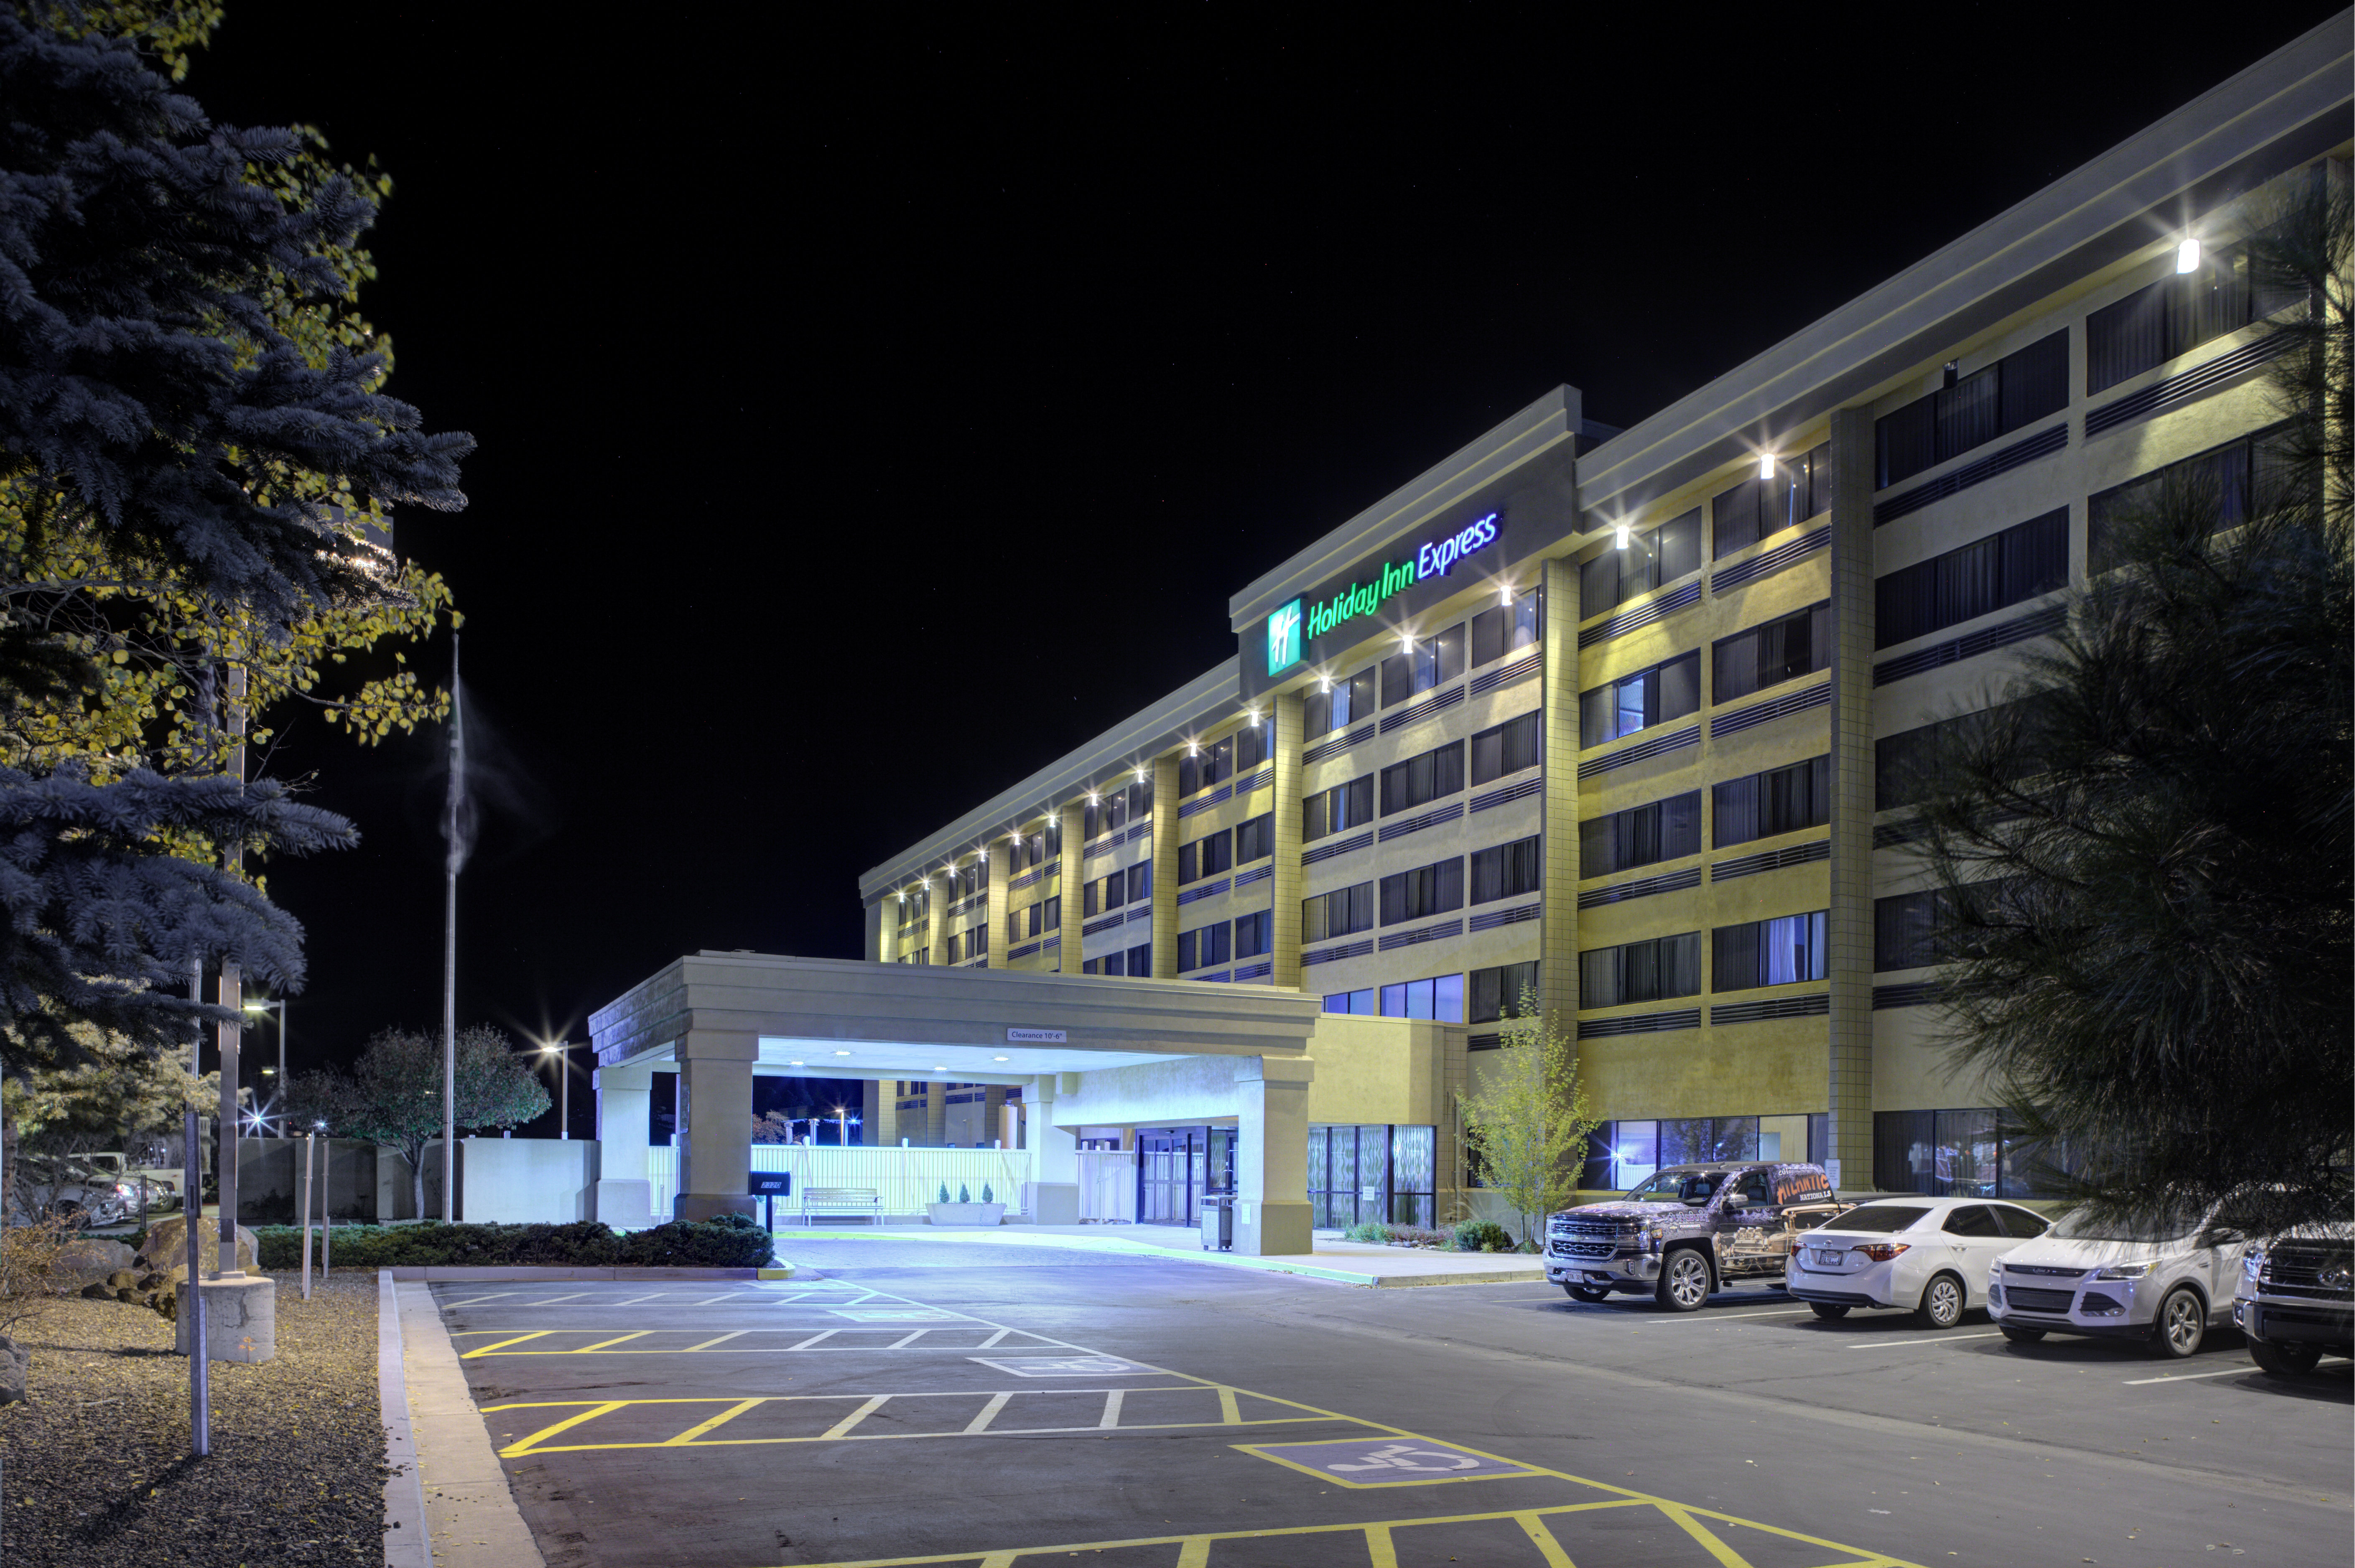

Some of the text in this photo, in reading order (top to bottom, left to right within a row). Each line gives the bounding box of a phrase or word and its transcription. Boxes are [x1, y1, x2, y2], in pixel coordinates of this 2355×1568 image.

[1308, 512, 1497, 639] Holiday Inn Express
[1778, 1167, 1792, 1176] 2017
[1776, 1173, 1830, 1205] ATLANTIC
[1799, 1190, 1832, 1201] NATIONALS
